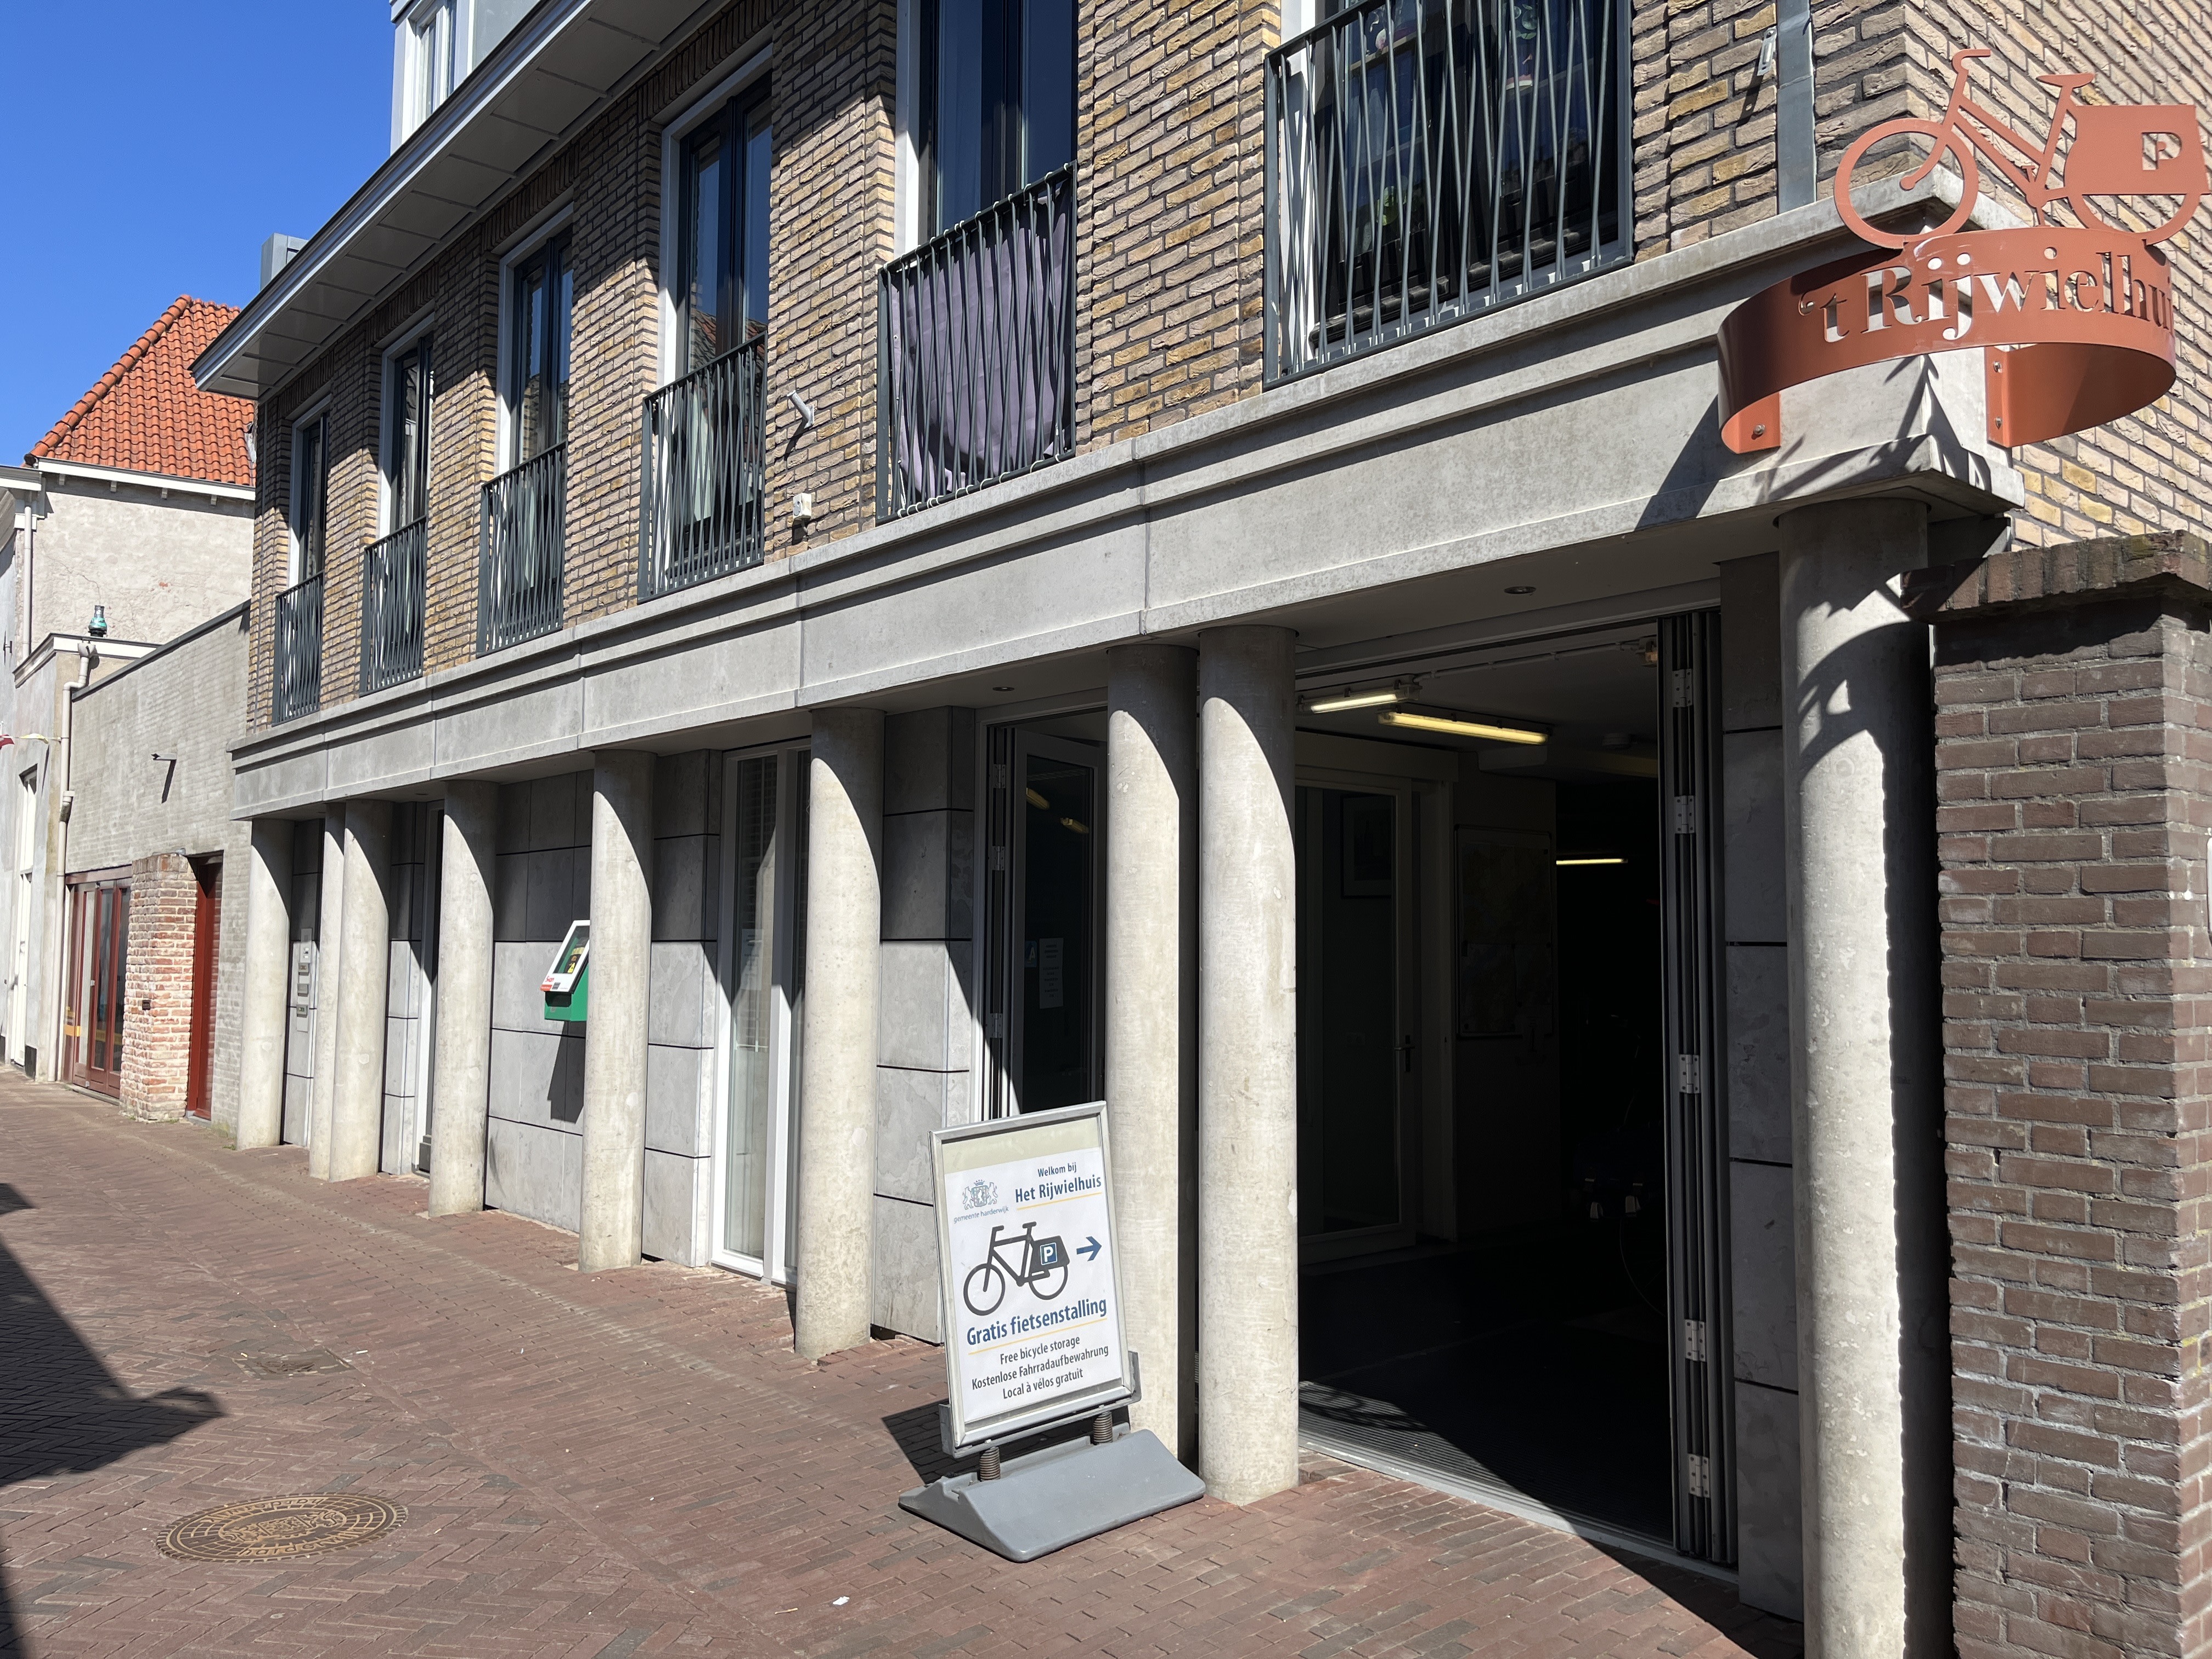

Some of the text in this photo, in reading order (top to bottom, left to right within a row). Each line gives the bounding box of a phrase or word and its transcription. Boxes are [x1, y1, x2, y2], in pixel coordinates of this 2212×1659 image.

[2141, 132, 2183, 171] P
[1798, 246, 2175, 343] 't Rijwielhui
[1038, 1161, 1077, 1177] Welkom bij
[1015, 1174, 1102, 1203] Het Rijwielhuis
[953, 1205, 1009, 1224] gemeente harderwijk
[1044, 1246, 1053, 1262] P
[967, 1298, 1107, 1346] Gratis fietsenstalling
[1000, 1336, 1080, 1365] Free bicycle storage
[972, 1345, 1109, 1390] Kostenlose Fahrradaufbewahrung
[1002, 1368, 1084, 1400] Local à vélos gratuit
